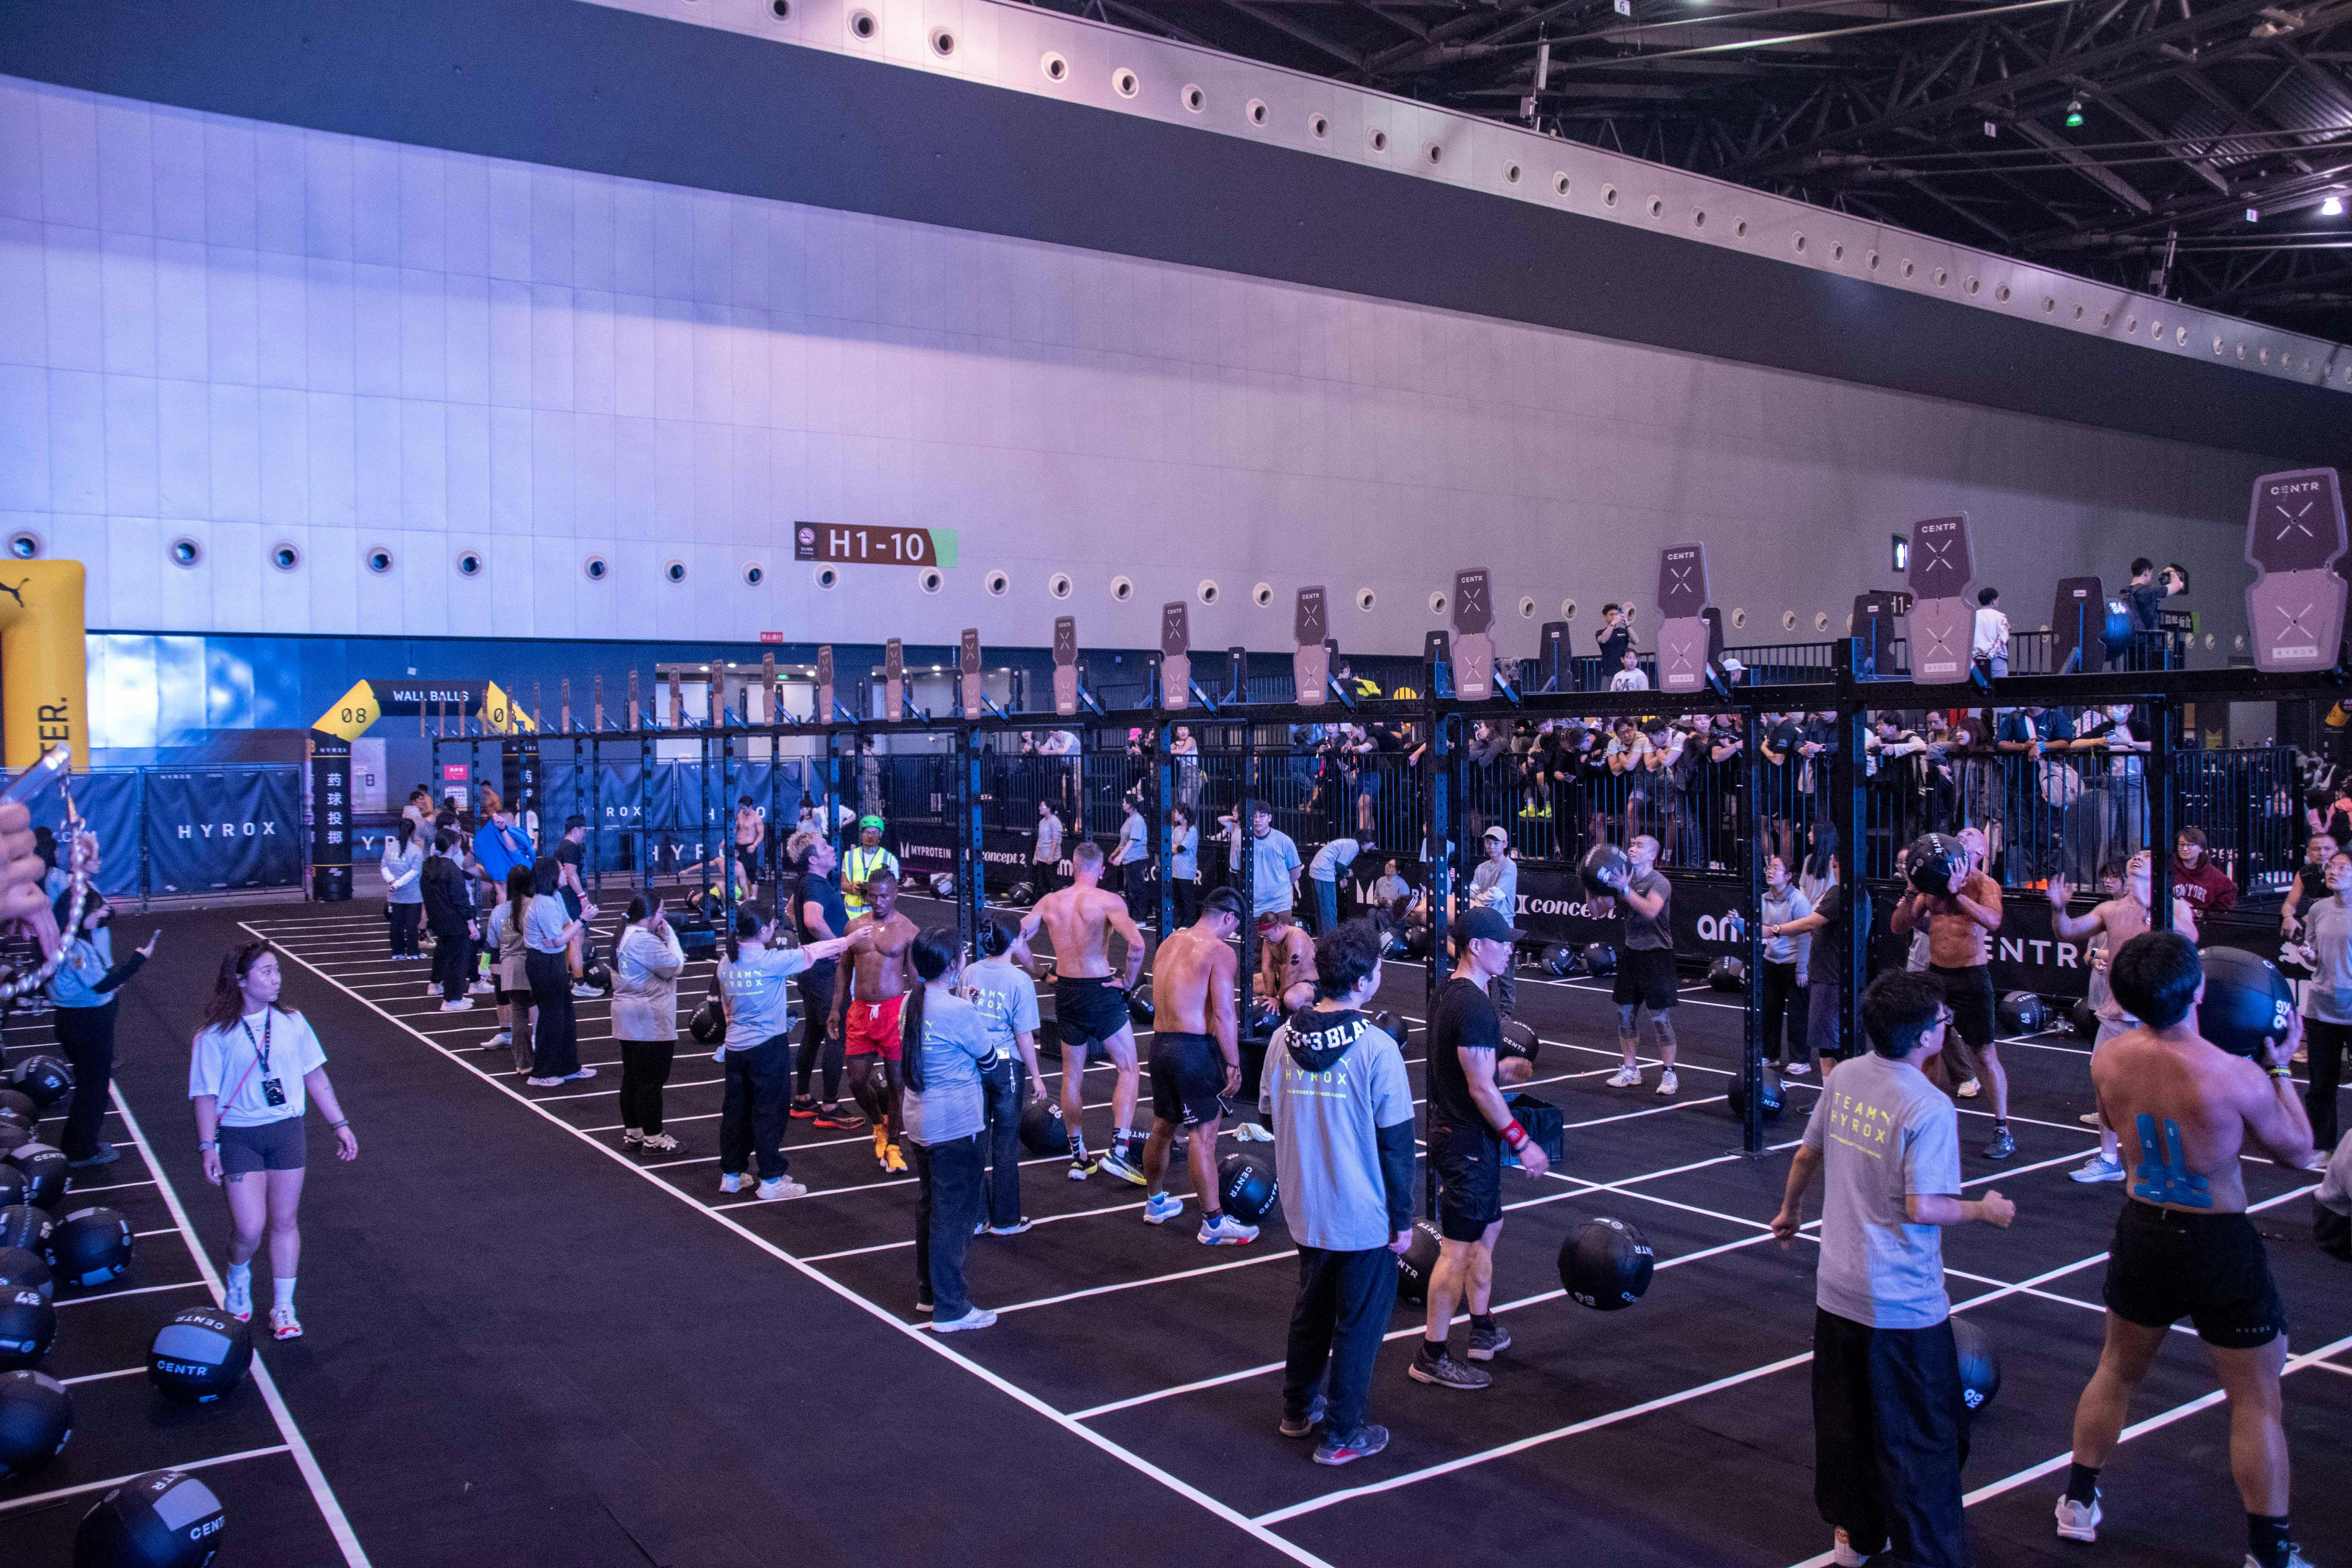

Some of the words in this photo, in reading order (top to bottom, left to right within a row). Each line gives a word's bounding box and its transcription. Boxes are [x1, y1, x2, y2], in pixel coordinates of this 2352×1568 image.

[1618, 0, 1624, 11] 6
[2270, 482, 2319, 495] CENTR
[1921, 523, 1956, 533] CENTR
[830, 529, 924, 561] H1-10
[1668, 552, 1695, 560] CENTR
[393, 691, 426, 701] WALL
[430, 691, 469, 701] BALLS
[342, 708, 366, 723] 08
[327, 773, 343, 844] 药球投掷
[178, 822, 276, 838] HYROX
[911, 845, 951, 859] MYPROTEIN
[982, 851, 1018, 865] oncept
[1984, 935, 2078, 969] ENTR
[978, 999, 1002, 1011] ROX
[1503, 1037, 1526, 1053] CENTR
[1285, 1069, 1347, 1085] HYROX
[1835, 1092, 1877, 1120] TEAM
[1831, 1110, 1885, 1143] HYROX
[1229, 1166, 1252, 1198] CENTR
[1259, 1183, 1278, 1214] CENTR
[1397, 1256, 1418, 1279] NTR
[175, 1316, 225, 1330] CENTR
[2235, 1325, 2271, 1334] HYROX
[157, 1360, 207, 1376] CENTR
[190, 1515, 225, 1541] CENT
